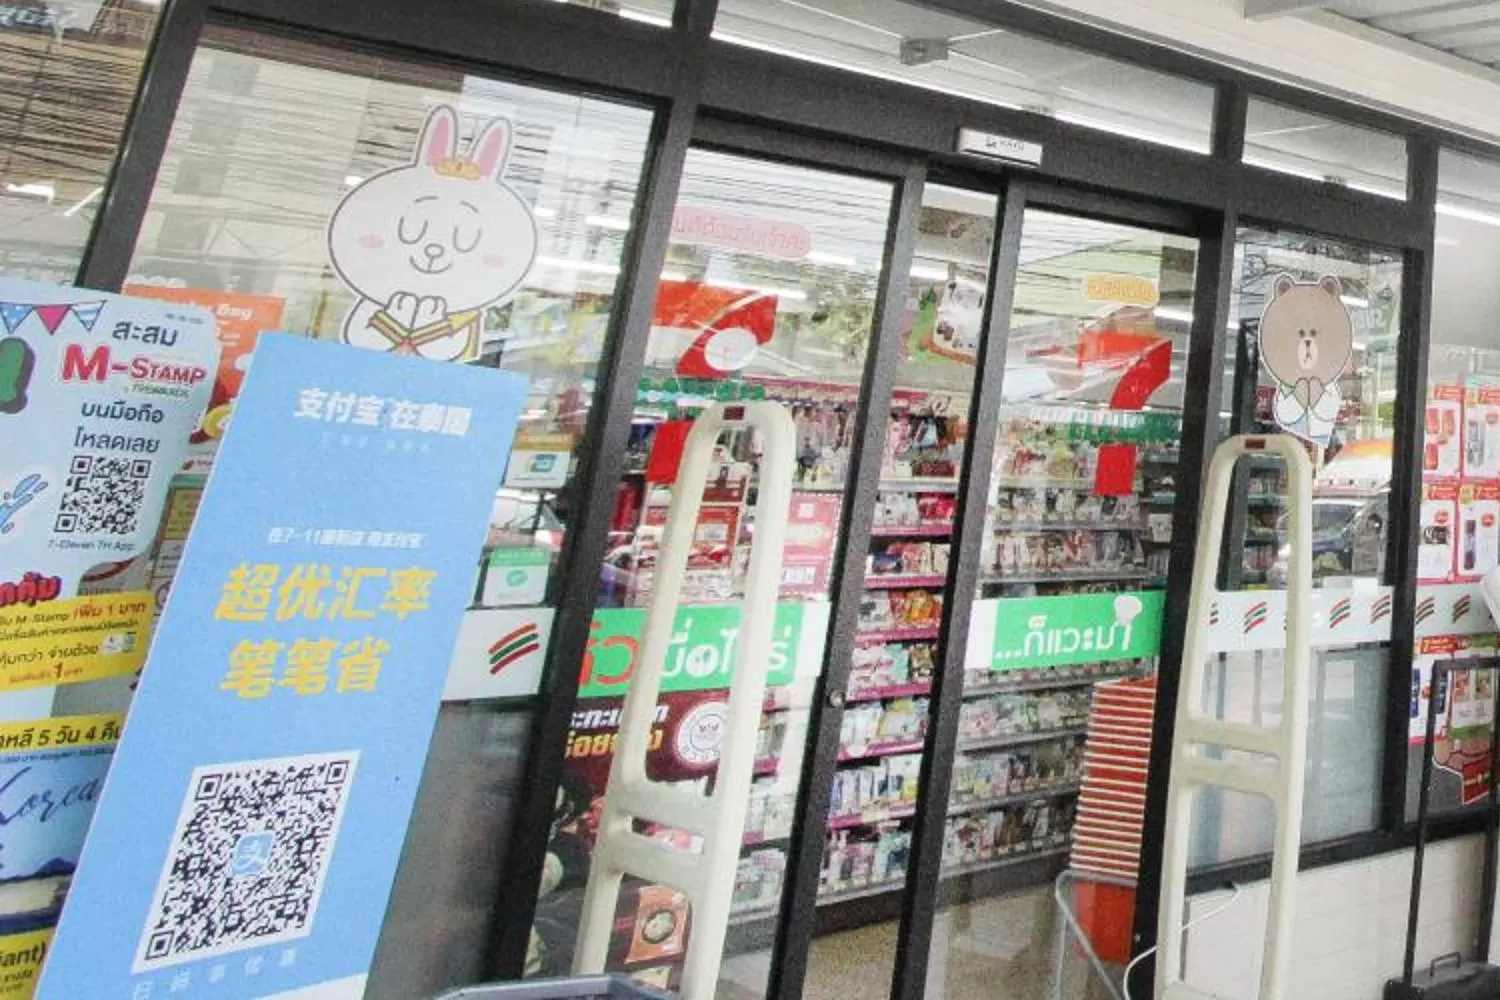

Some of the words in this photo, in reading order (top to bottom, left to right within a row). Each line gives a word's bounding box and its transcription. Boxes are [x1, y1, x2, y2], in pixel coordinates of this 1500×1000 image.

[112, 321, 178, 347] สะสม
[81, 400, 165, 424] บนมือถือ
[74, 426, 160, 453] โหลดเลย
[214, 561, 438, 622] 超优汇率
[219, 635, 392, 699] 笔笔省
[38, 728, 50, 747] 5
[55, 726, 80, 745] วัน
[85, 726, 97, 742] 4
